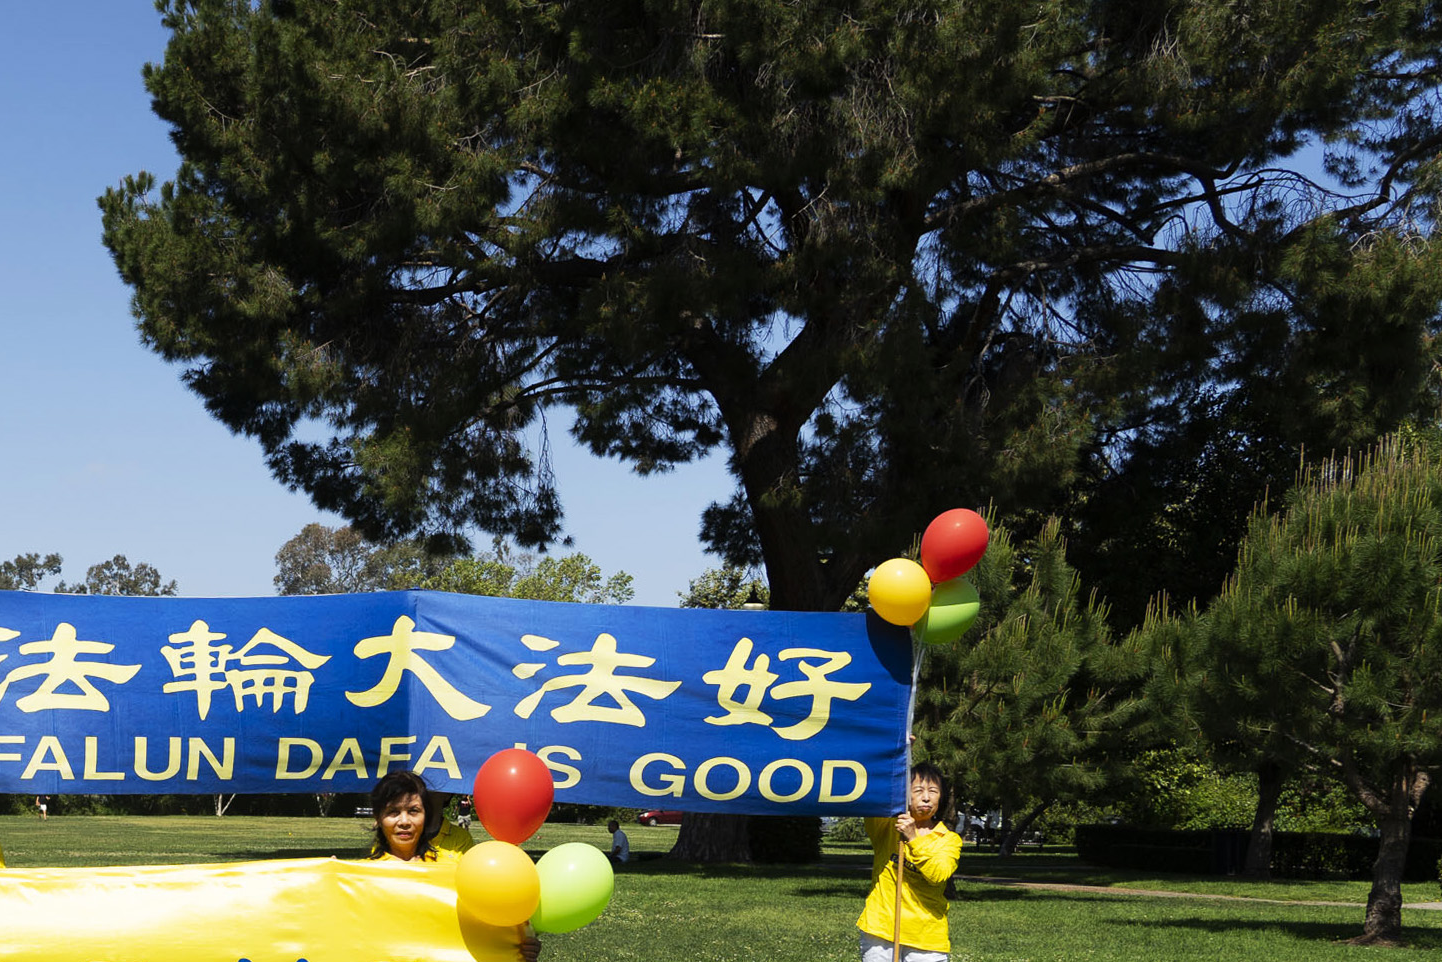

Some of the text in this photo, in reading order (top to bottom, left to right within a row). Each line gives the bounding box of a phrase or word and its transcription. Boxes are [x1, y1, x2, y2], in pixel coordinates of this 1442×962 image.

[275, 735, 463, 780] DAFA
[514, 742, 583, 790] S
[629, 752, 868, 803] GOOD
